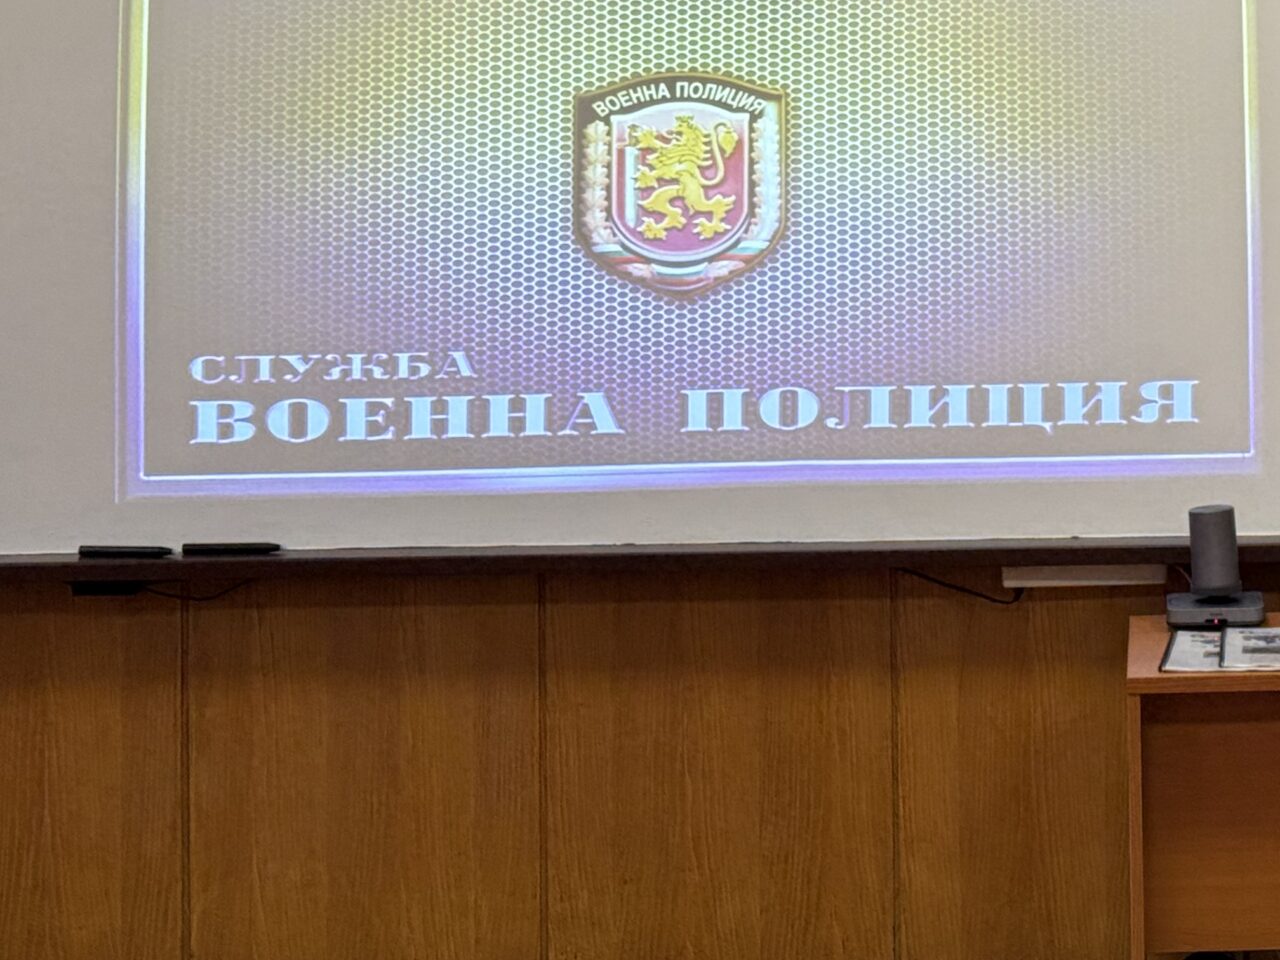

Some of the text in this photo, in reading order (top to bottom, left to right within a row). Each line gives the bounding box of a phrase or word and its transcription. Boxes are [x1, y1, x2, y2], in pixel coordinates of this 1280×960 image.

[592, 81, 768, 117] ВОЕННА ПОЛИЦИЯ
[188, 350, 477, 385] СЛУЖБА
[190, 379, 1202, 446] ВОЕННА ПОЛИЦИЯ
